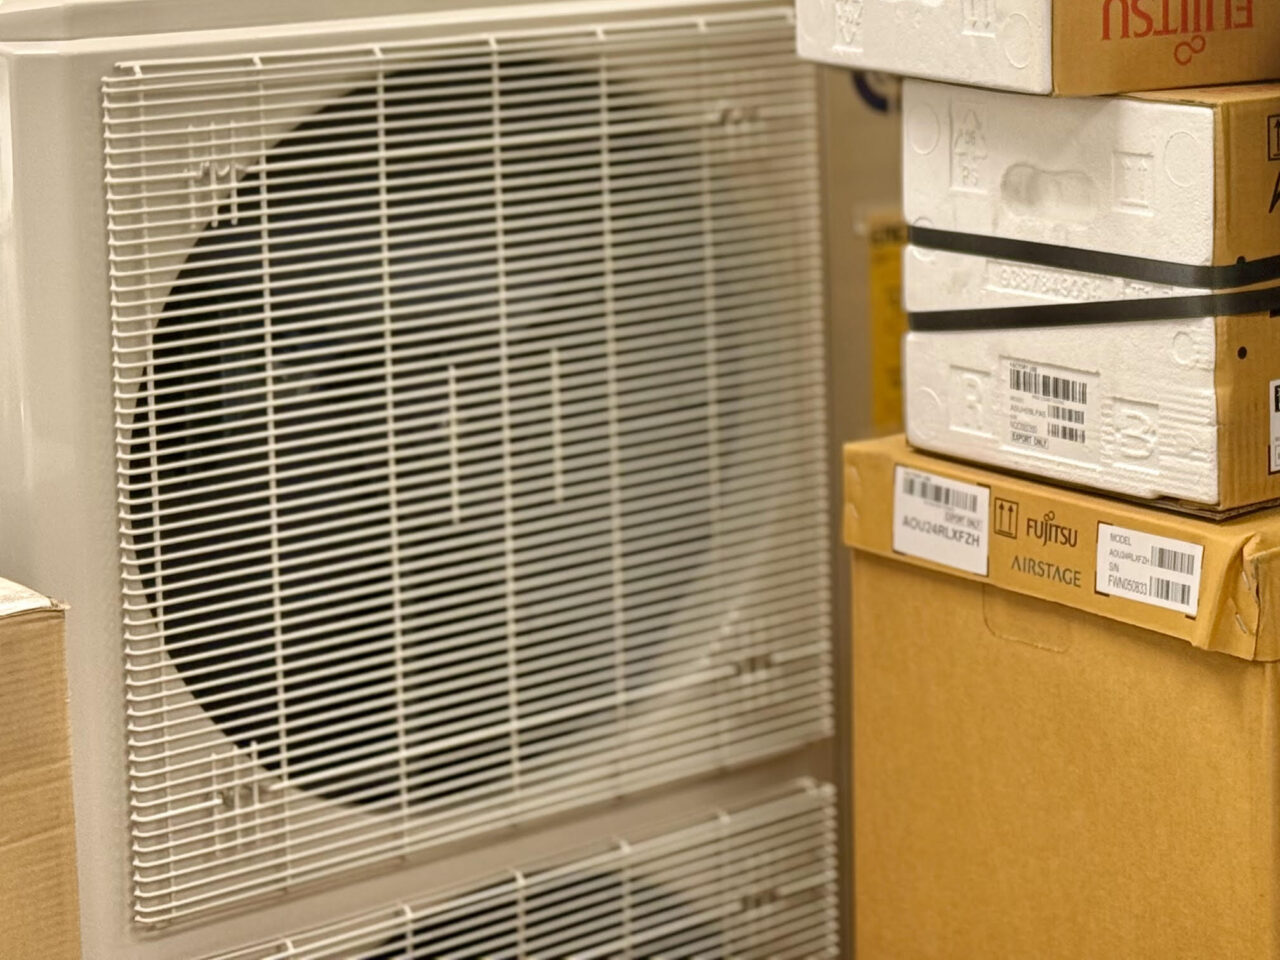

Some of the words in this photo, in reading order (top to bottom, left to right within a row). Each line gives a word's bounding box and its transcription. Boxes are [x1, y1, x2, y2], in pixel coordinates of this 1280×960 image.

[902, 514, 980, 547] AOU24RLXFZH
[1026, 511, 1079, 548] FUJITSU
[1110, 533, 1132, 546] MODEL
[1011, 554, 1082, 588] AIRSTAGE
